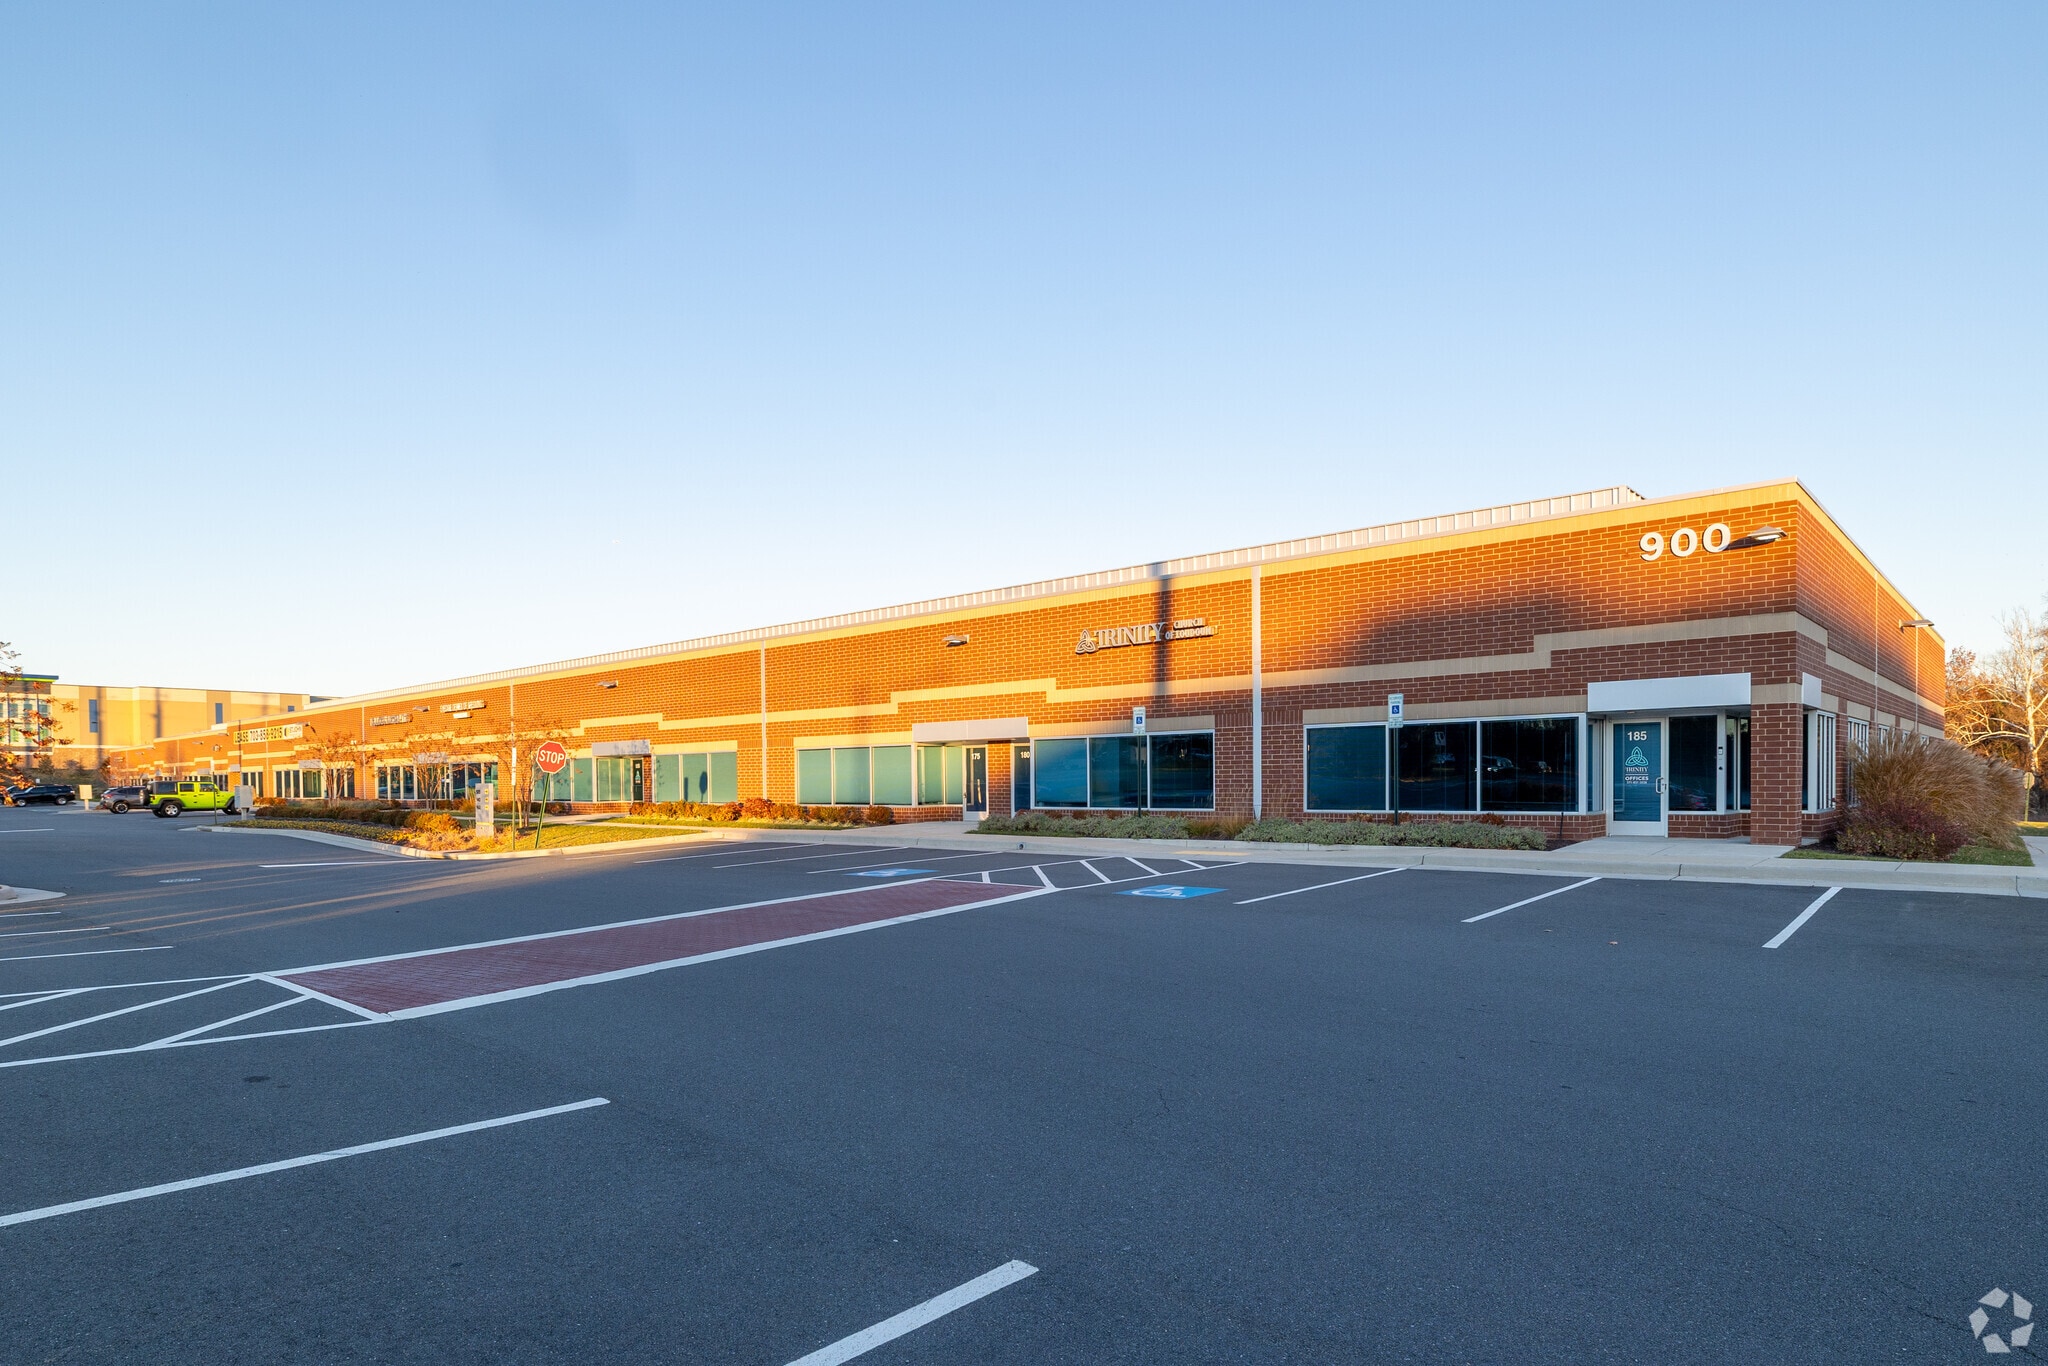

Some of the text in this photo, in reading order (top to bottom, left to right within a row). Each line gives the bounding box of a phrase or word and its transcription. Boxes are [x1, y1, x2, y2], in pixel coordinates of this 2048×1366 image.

[1639, 523, 1731, 562] 900
[1095, 622, 1166, 648] TRINITY
[1627, 731, 1647, 741] 185
[539, 750, 564, 764] STOP
